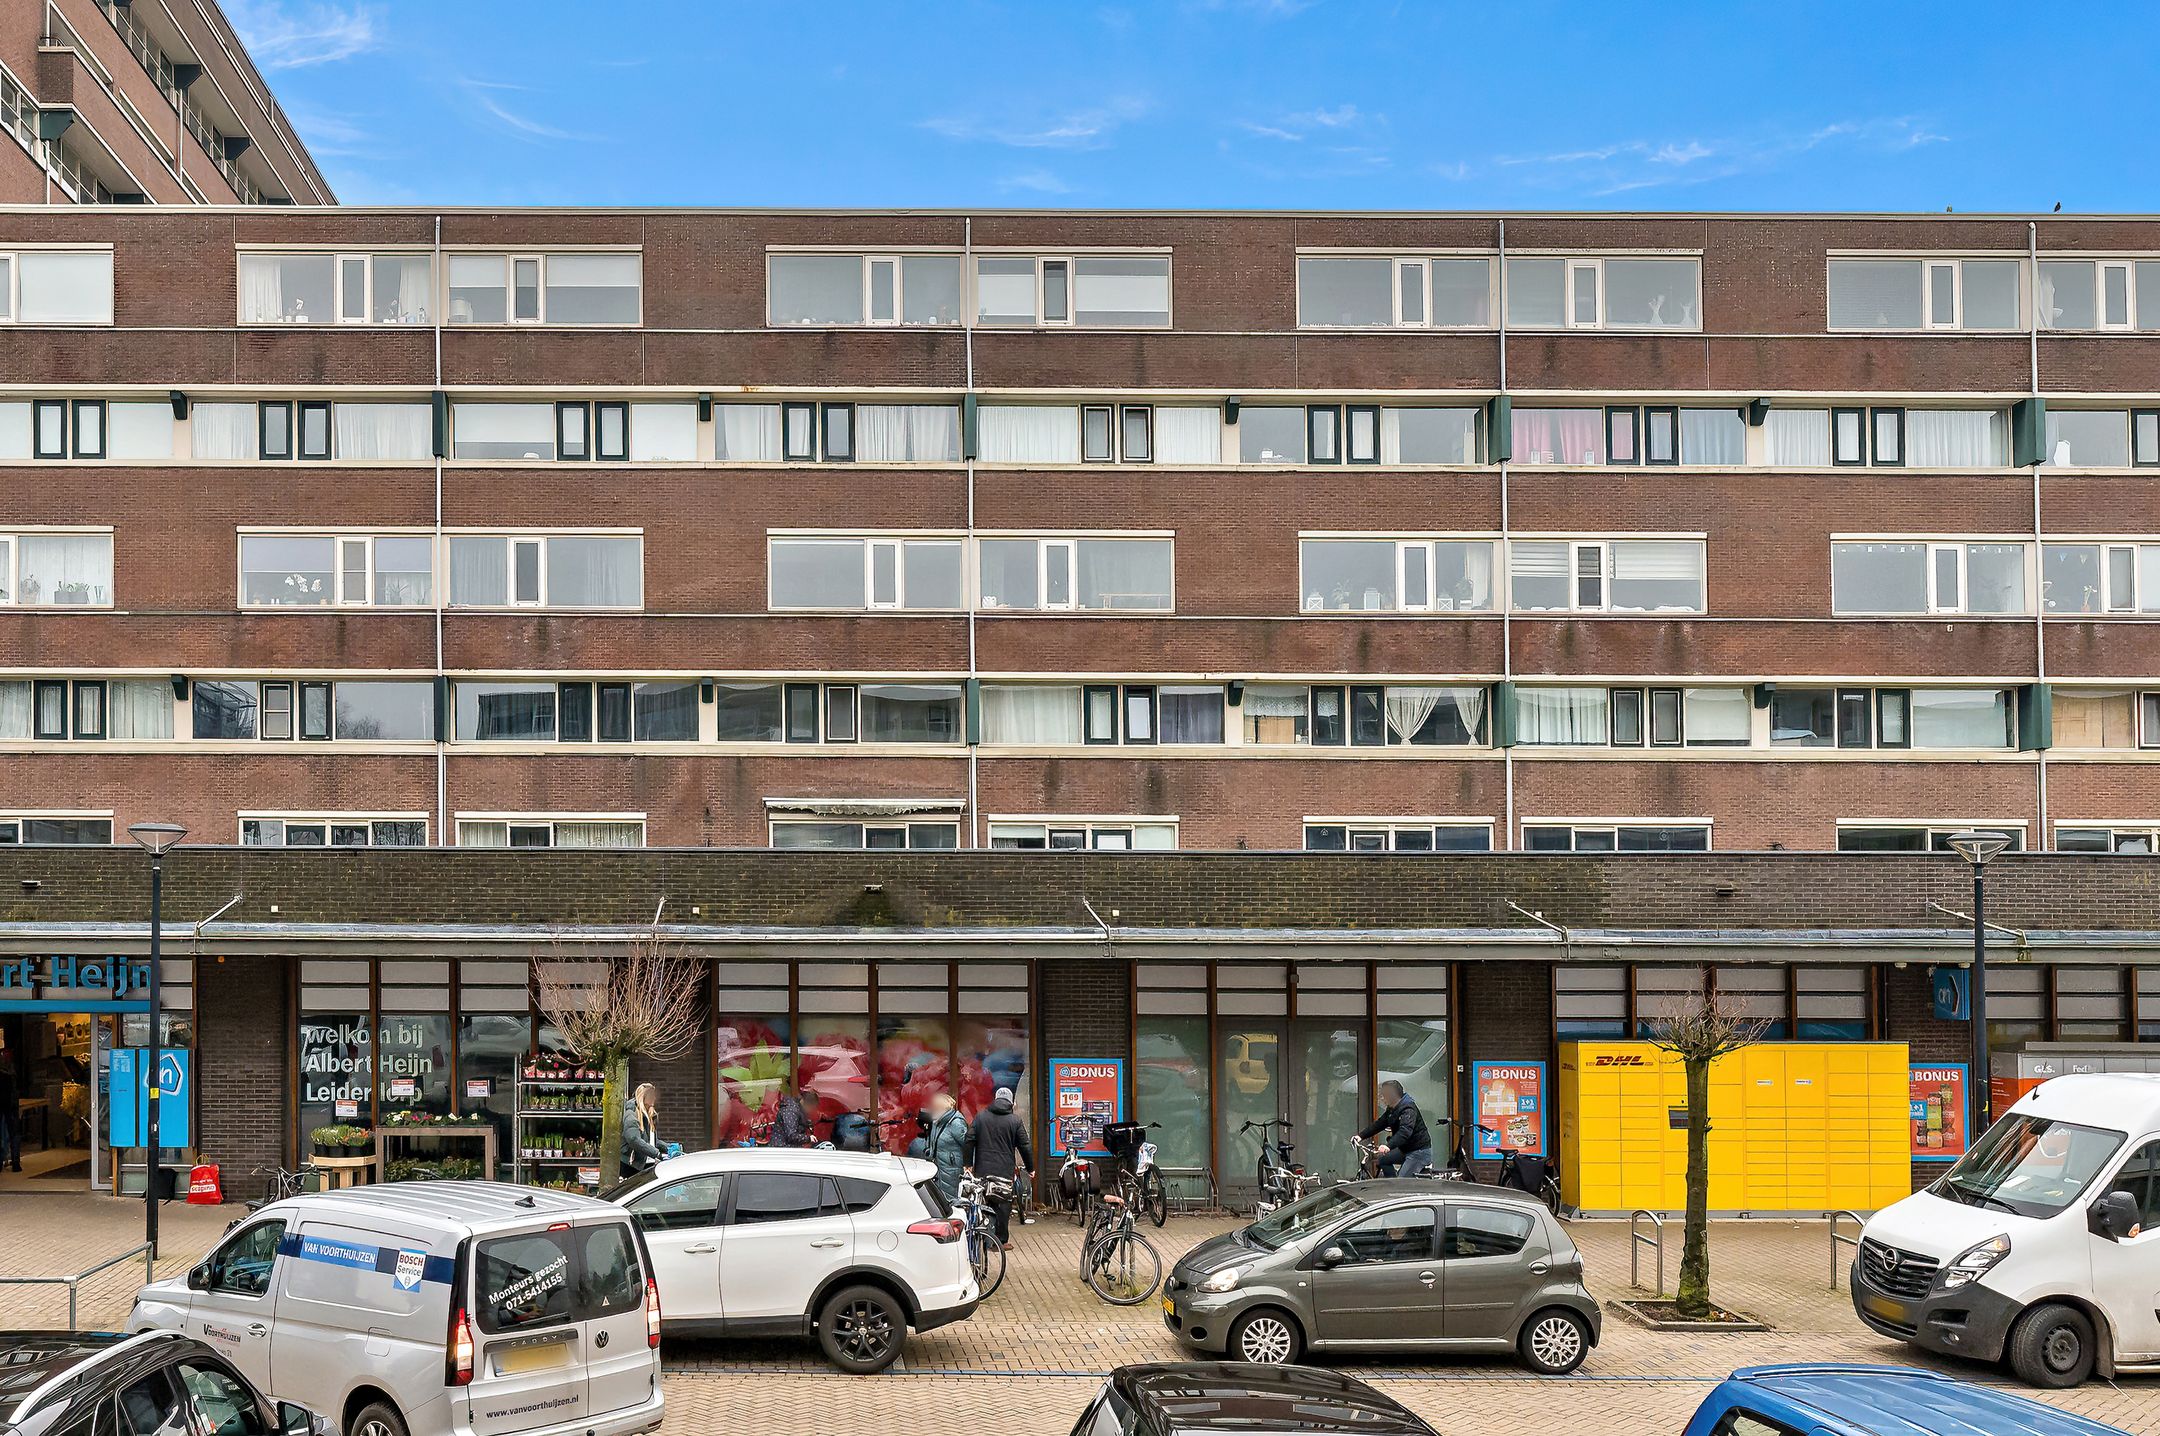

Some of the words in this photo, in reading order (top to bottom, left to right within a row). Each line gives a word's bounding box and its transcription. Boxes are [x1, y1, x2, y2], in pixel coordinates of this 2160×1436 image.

[51, 956, 151, 997] Heijn
[398, 1024, 423, 1048] bij
[305, 1053, 372, 1073] Albert
[380, 1053, 432, 1076] Heijn
[1596, 1056, 1644, 1066] DHL
[1070, 1067, 1115, 1078] BONUS
[1492, 1069, 1537, 1080] BONUS
[1914, 1071, 1959, 1081] BONUS
[304, 1242, 318, 1253] VAN
[320, 1245, 376, 1264] VOORTHUIJZEN
[399, 1254, 424, 1267] BOSCH
[397, 1264, 422, 1277] Service
[488, 1274, 534, 1305] Monteurs
[534, 1255, 569, 1283] gezocht
[505, 1272, 563, 1311] 071-5414155
[486, 1394, 579, 1418] www.vanvoorthuijzen.nl
